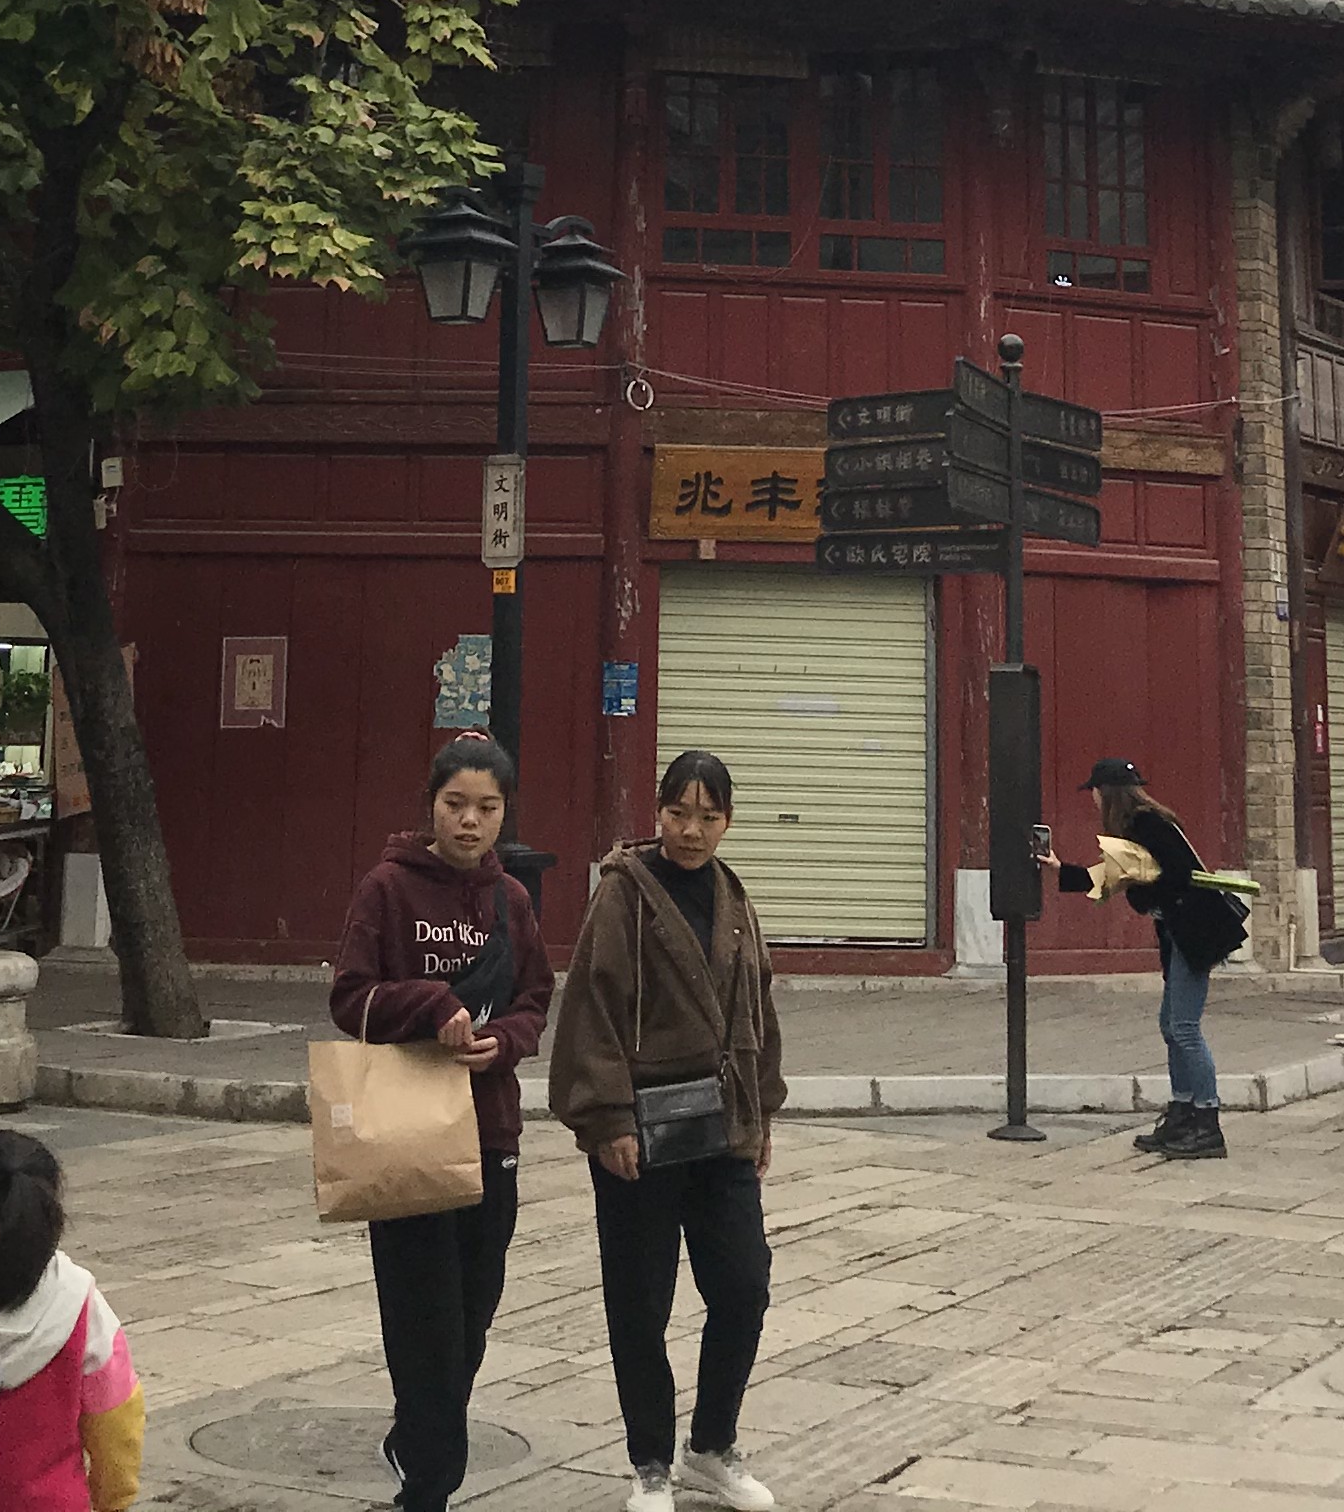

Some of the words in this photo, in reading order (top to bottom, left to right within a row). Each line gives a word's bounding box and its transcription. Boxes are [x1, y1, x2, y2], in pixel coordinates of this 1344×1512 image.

[491, 474, 510, 549] 文明街
[675, 470, 829, 522] 兆丰
[414, 919, 464, 942] Don't
